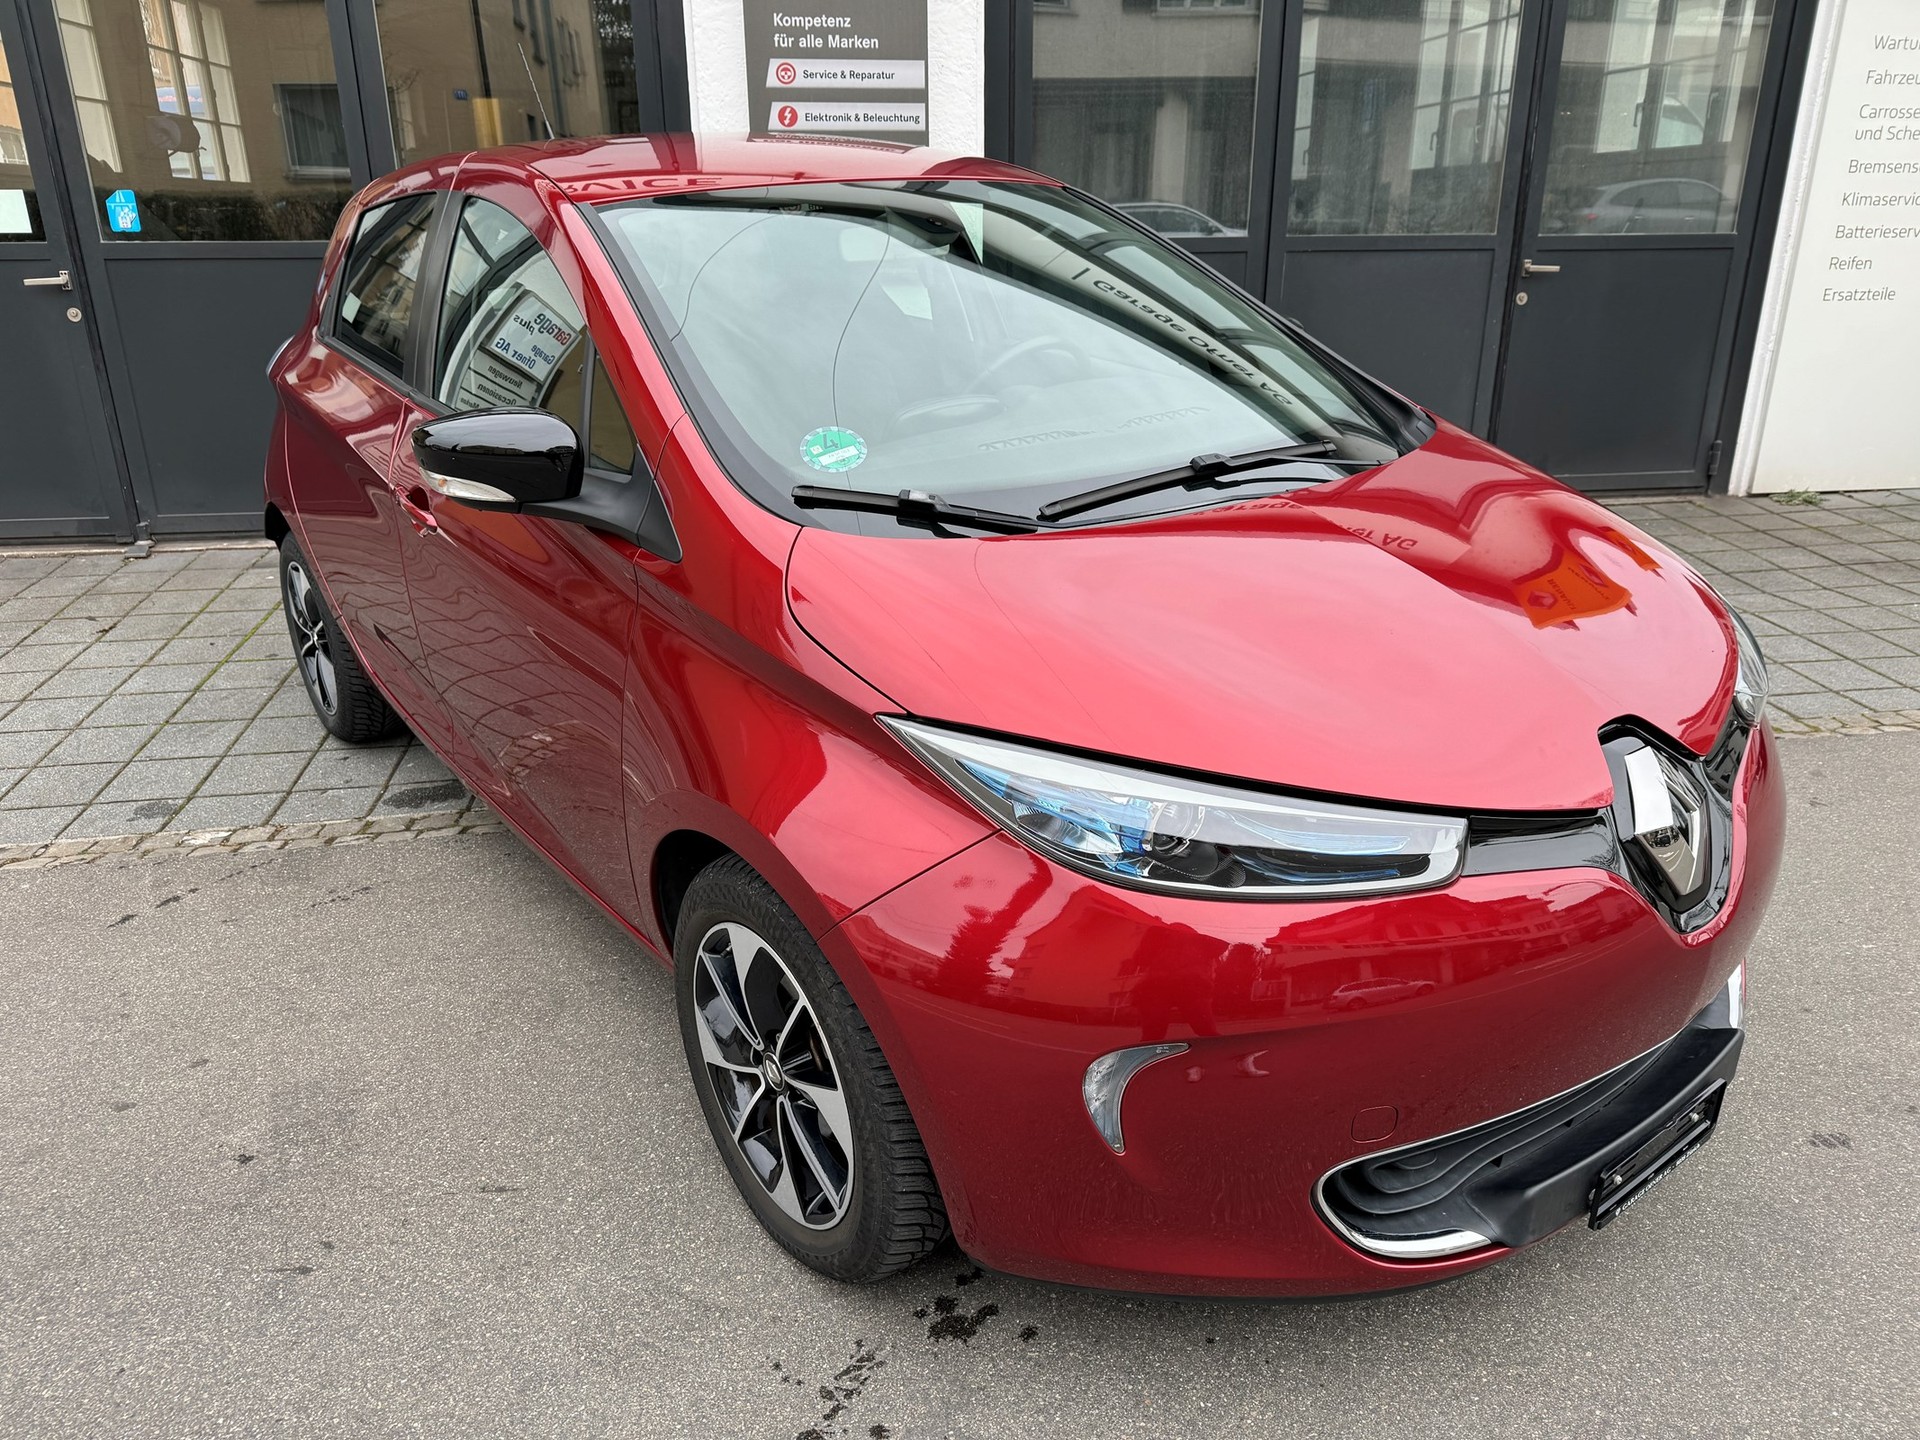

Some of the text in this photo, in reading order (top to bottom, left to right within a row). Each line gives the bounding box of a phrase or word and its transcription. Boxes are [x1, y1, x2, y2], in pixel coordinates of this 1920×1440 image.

[773, 13, 851, 30] Kompetenz
[774, 33, 879, 49] für alle Marken
[1874, 35, 1920, 50] Wartu
[803, 69, 896, 82] Service & Reparatur
[804, 112, 920, 125] Elektronik & Beleuchtung
[1859, 104, 1920, 119] Carrosse
[1854, 125, 1920, 141] und Sche
[1848, 159, 1920, 174] Bremsens
[1841, 192, 1920, 207] Klimaservic
[1835, 225, 1920, 239] Batterieserv
[1829, 256, 1873, 271] Reifen
[1822, 286, 1896, 302] Ersatzteile
